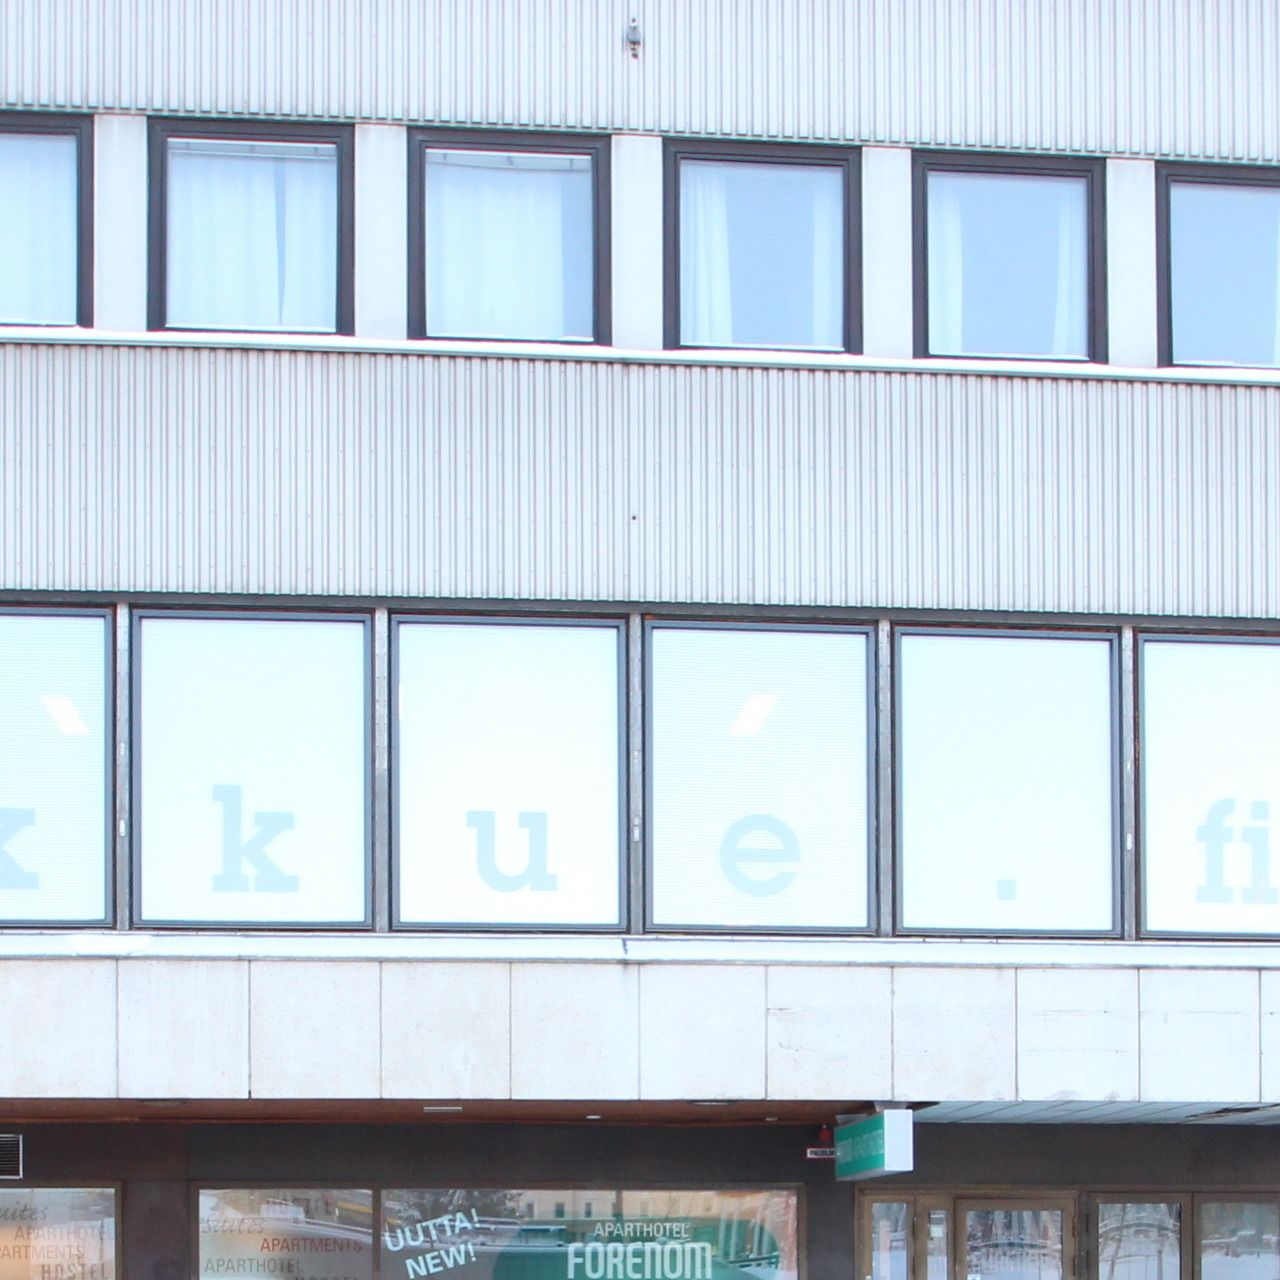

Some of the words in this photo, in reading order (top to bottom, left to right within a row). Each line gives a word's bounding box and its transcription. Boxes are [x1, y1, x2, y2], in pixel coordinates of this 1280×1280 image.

[384, 1208, 480, 1251] UUTTA!
[594, 1222, 690, 1238] APARTHOTEL
[260, 1238, 362, 1252] APARTMENTS
[205, 1258, 304, 1273] APARTHOTEL
[405, 1242, 477, 1280] NEW!
[567, 1242, 713, 1279] FORENOM
[41, 1263, 108, 1280] HOSTEL
